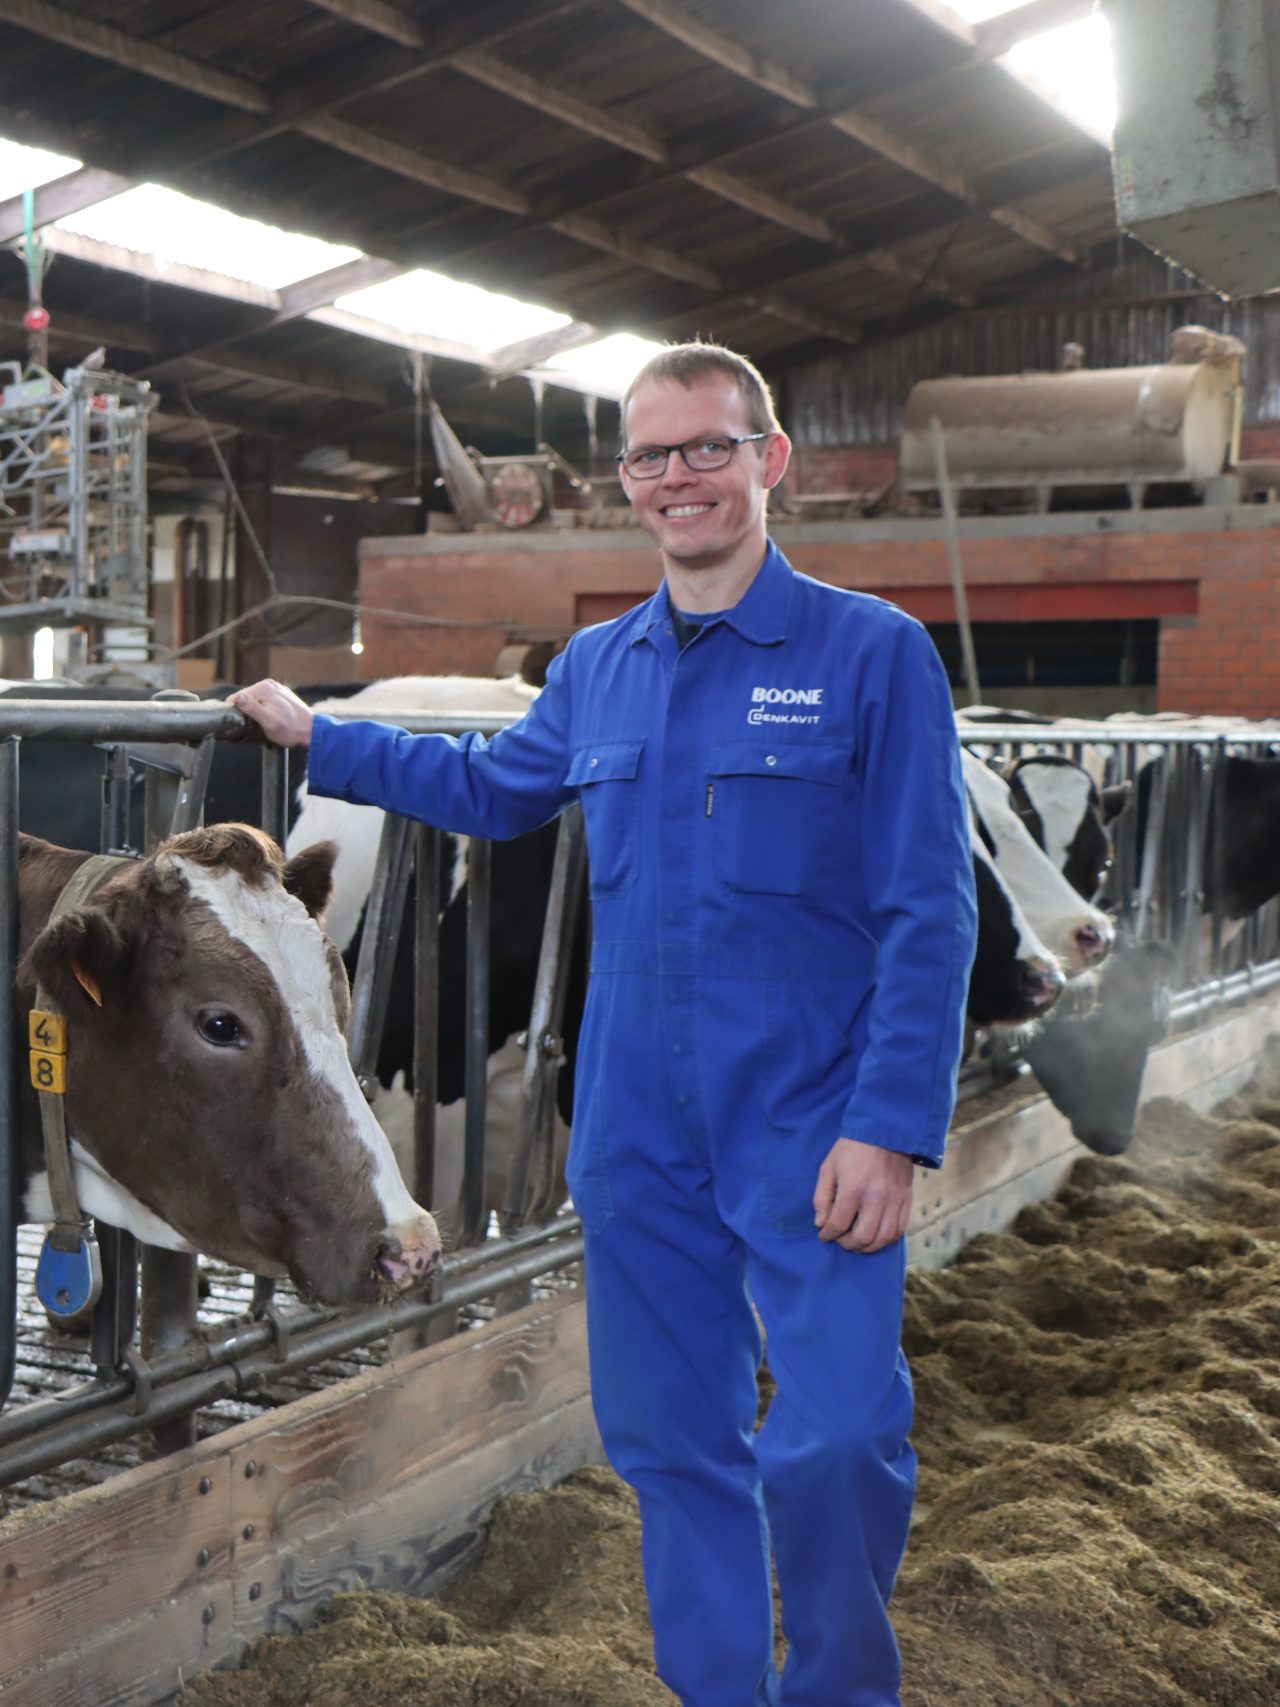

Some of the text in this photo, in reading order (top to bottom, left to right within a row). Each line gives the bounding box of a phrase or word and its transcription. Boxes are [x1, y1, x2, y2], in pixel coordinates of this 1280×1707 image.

[751, 687, 824, 705] BOONE
[35, 1018, 52, 1047] 4
[37, 1058, 54, 1087] 8
